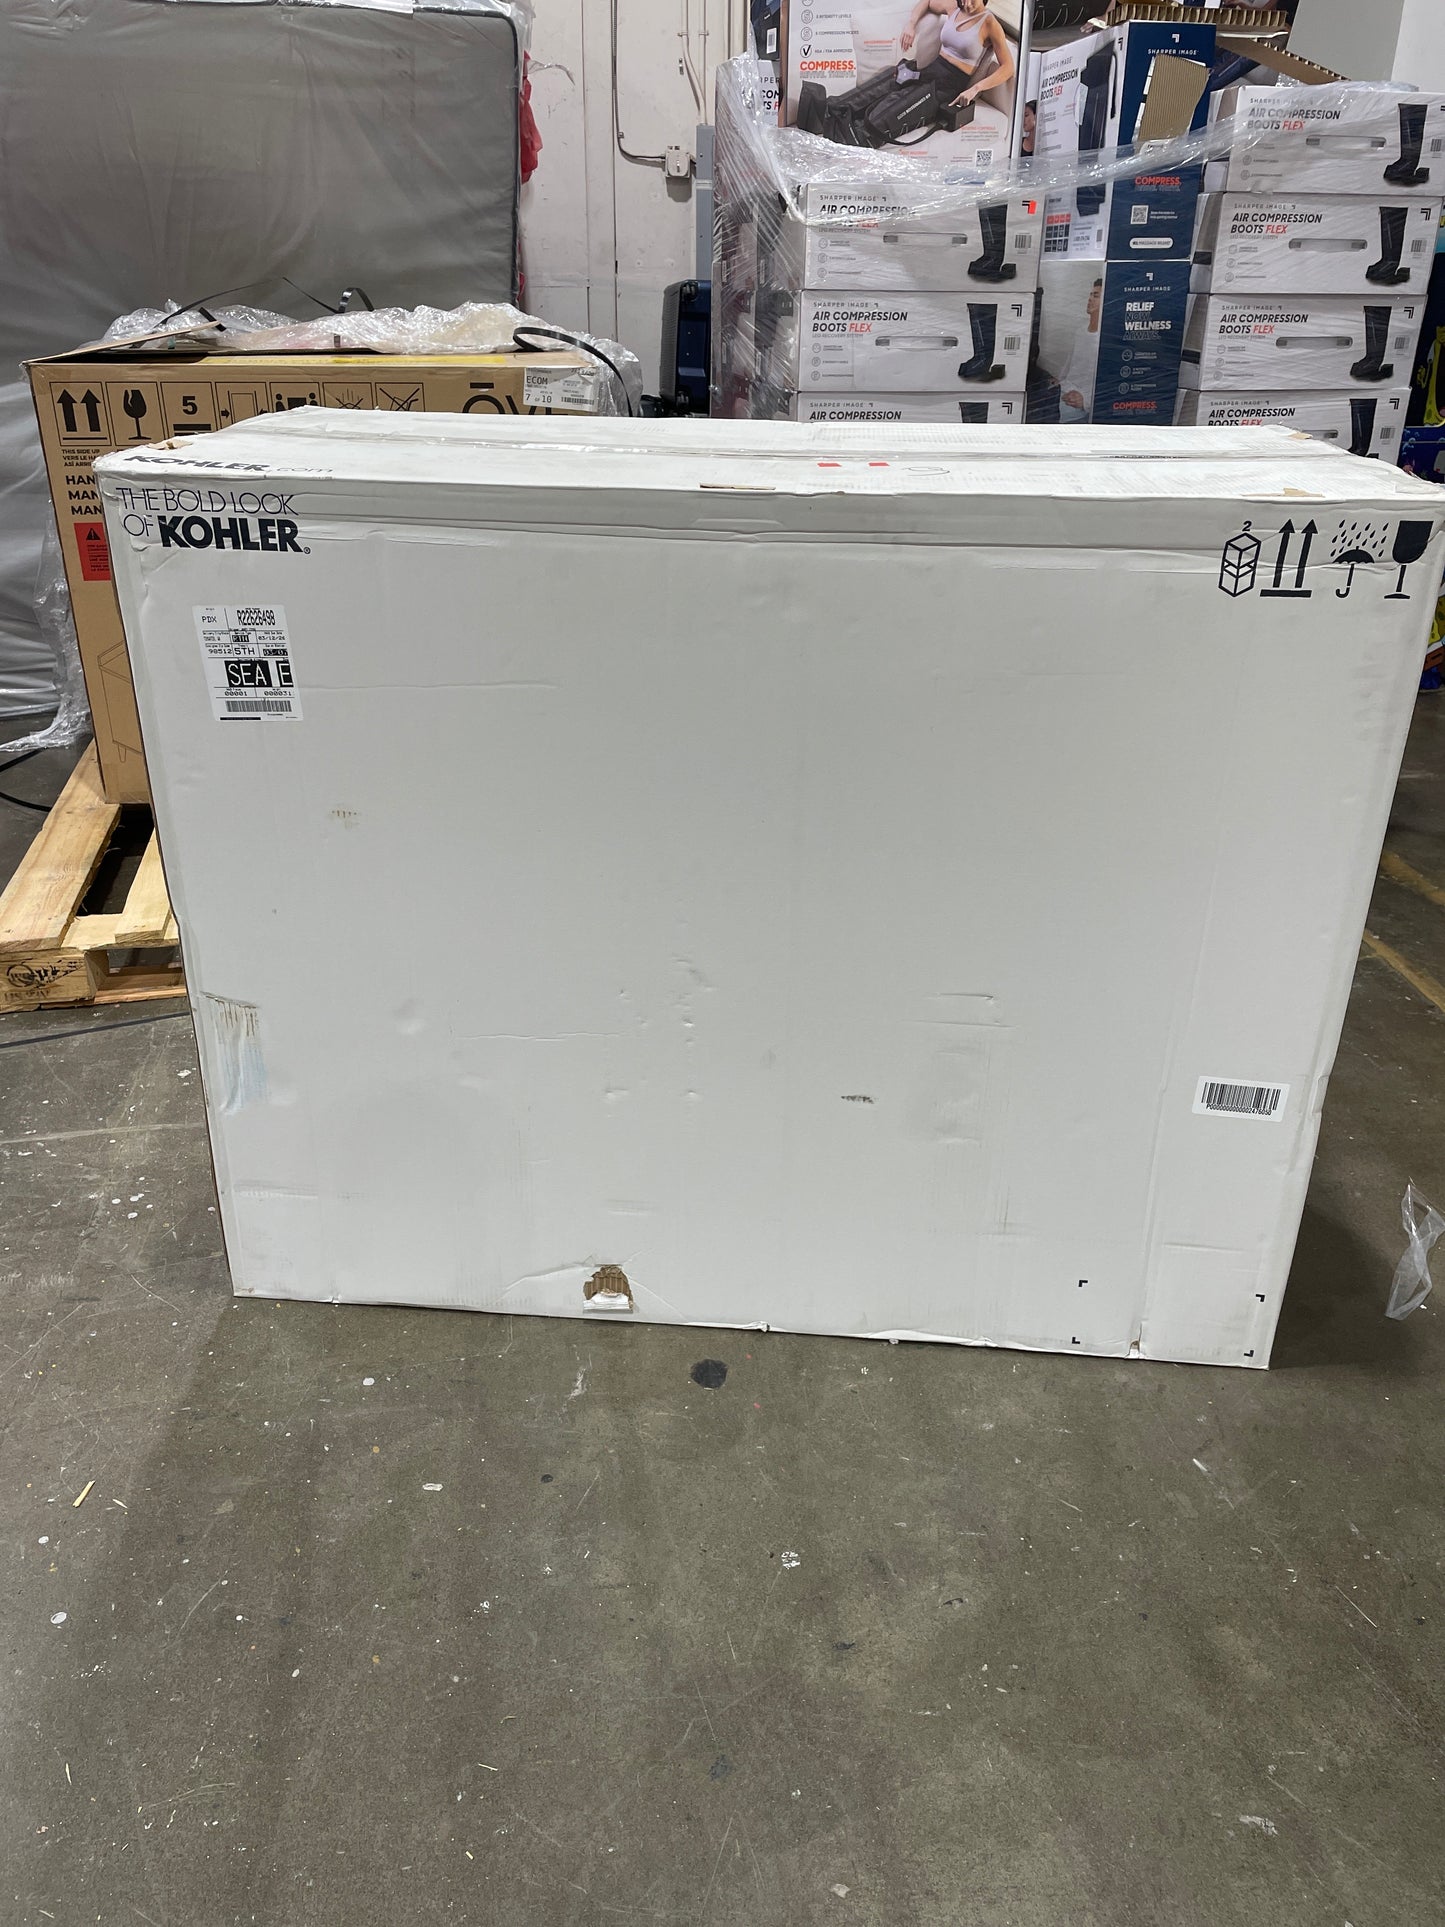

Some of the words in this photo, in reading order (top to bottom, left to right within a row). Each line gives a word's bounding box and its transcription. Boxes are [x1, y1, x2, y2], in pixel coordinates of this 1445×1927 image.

[800, 60, 857, 71] COMPRESS.
[1048, 68, 1080, 87] COMPRESSION
[1040, 87, 1054, 101] BOOTS
[1053, 85, 1064, 97] FLEX
[1249, 107, 1267, 118] AIR
[1267, 108, 1341, 120] COMPRESSION
[1247, 120, 1281, 130] BOOTS
[1281, 120, 1306, 131] FLEX
[819, 204, 838, 214] AIR
[1232, 212, 1250, 223] AIR
[1251, 213, 1323, 224] COMPRESSION
[1230, 224, 1265, 234] BOOTS
[1265, 224, 1289, 234] FLEX
[1125, 301, 1155, 311] RELIEF
[812, 311, 831, 321] AIR
[832, 311, 909, 321] COMPRESSION
[1220, 314, 1238, 323] AIR
[1238, 314, 1309, 323] COMPRESSION
[812, 322, 848, 332] BOOTS
[848, 322, 873, 333] FLEX
[1124, 320, 1172, 331] WELLNESS
[1218, 324, 1252, 334] BOOTS
[1252, 324, 1276, 335] FLEX
[526, 375, 548, 385] ECOM
[525, 393, 531, 401] 7
[542, 394, 552, 403] 10
[182, 395, 198, 415] 5
[809, 411, 827, 420] AIR
[828, 411, 902, 420] COMPRESSION
[1208, 409, 1226, 418] AIR
[1226, 407, 1296, 418] COMPRESSION
[115, 487, 161, 511] THE
[163, 486, 227, 513] BOLD
[230, 491, 299, 515] LOOK
[123, 513, 154, 537] OF
[1241, 520, 1253, 531] 2
[234, 647, 256, 656] 5TH
[227, 662, 268, 686] SEA
